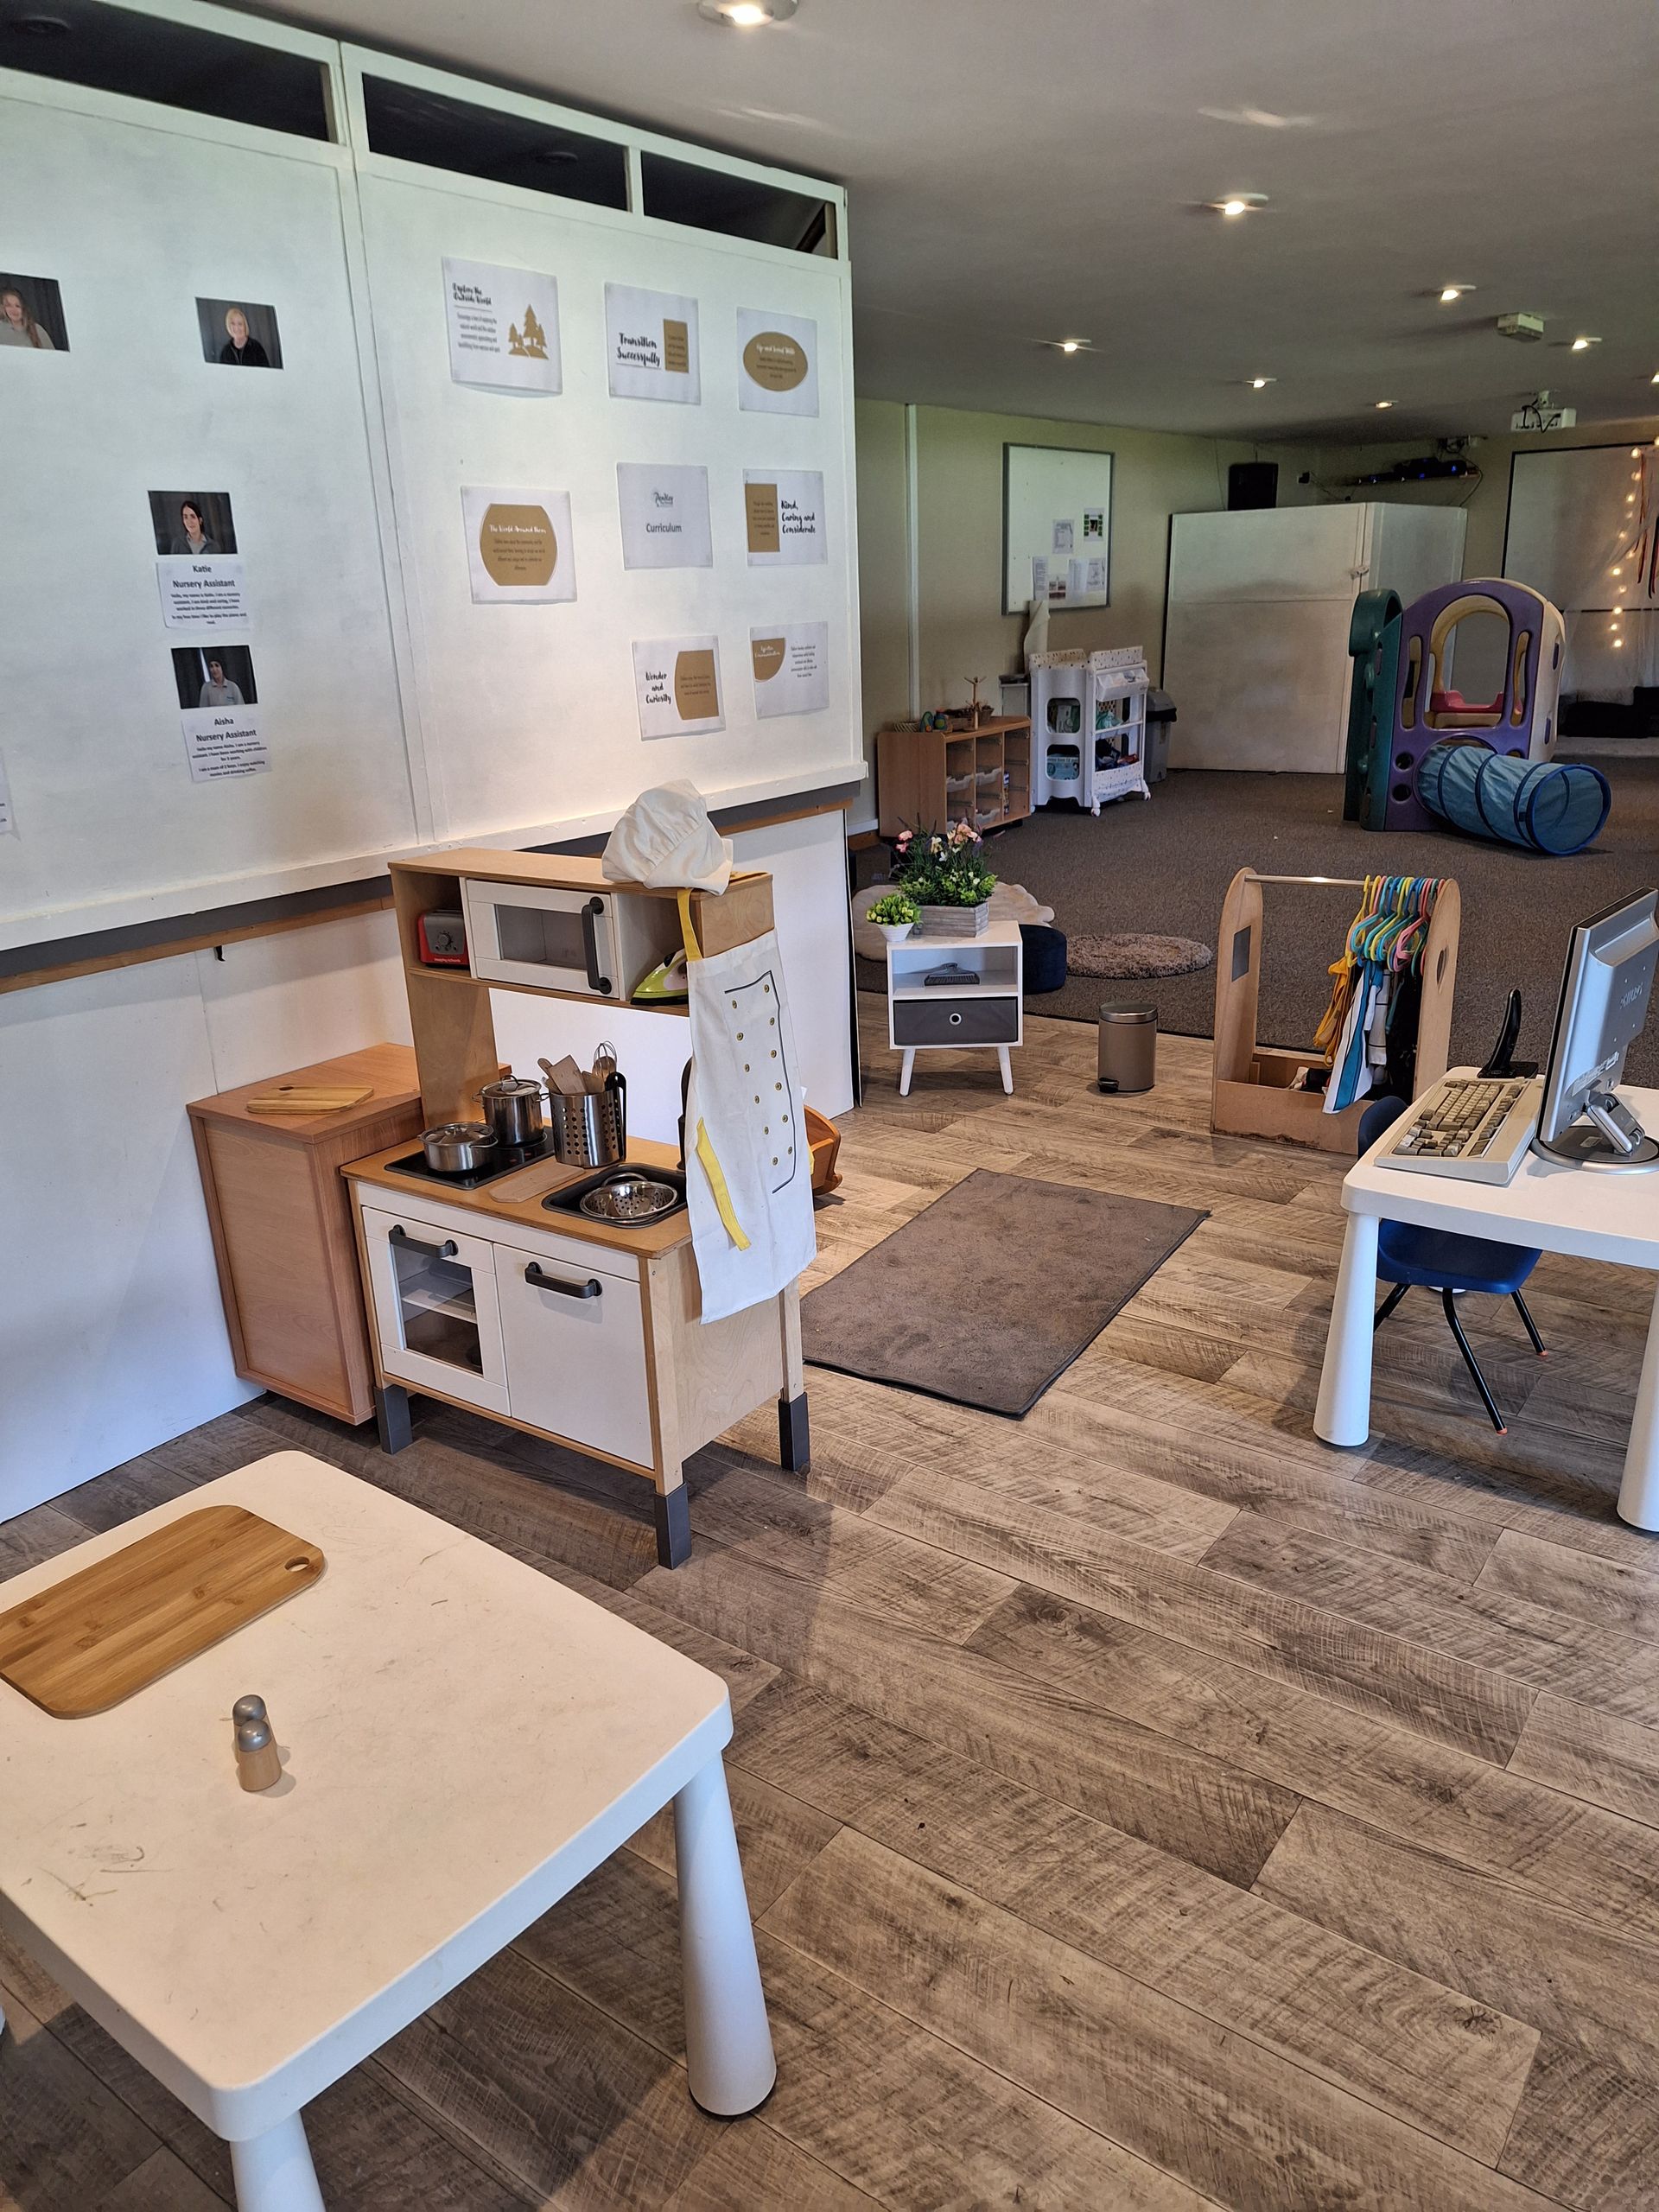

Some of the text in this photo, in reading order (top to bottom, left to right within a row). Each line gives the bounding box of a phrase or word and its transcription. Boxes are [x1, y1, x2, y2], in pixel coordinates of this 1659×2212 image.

[619, 332, 657, 349] Transition
[617, 346, 660, 367] Successfully
[781, 500, 799, 511] Kind,
[781, 512, 815, 529] Caring and
[645, 522, 683, 533] Curriculum
[782, 524, 816, 534] Considerate
[172, 579, 236, 589] Nursery Assistant
[645, 671, 667, 681] Wonder
[652, 682, 664, 691] and
[645, 694, 671, 705] Curiosity
[195, 729, 257, 742] Nursery Assistant
